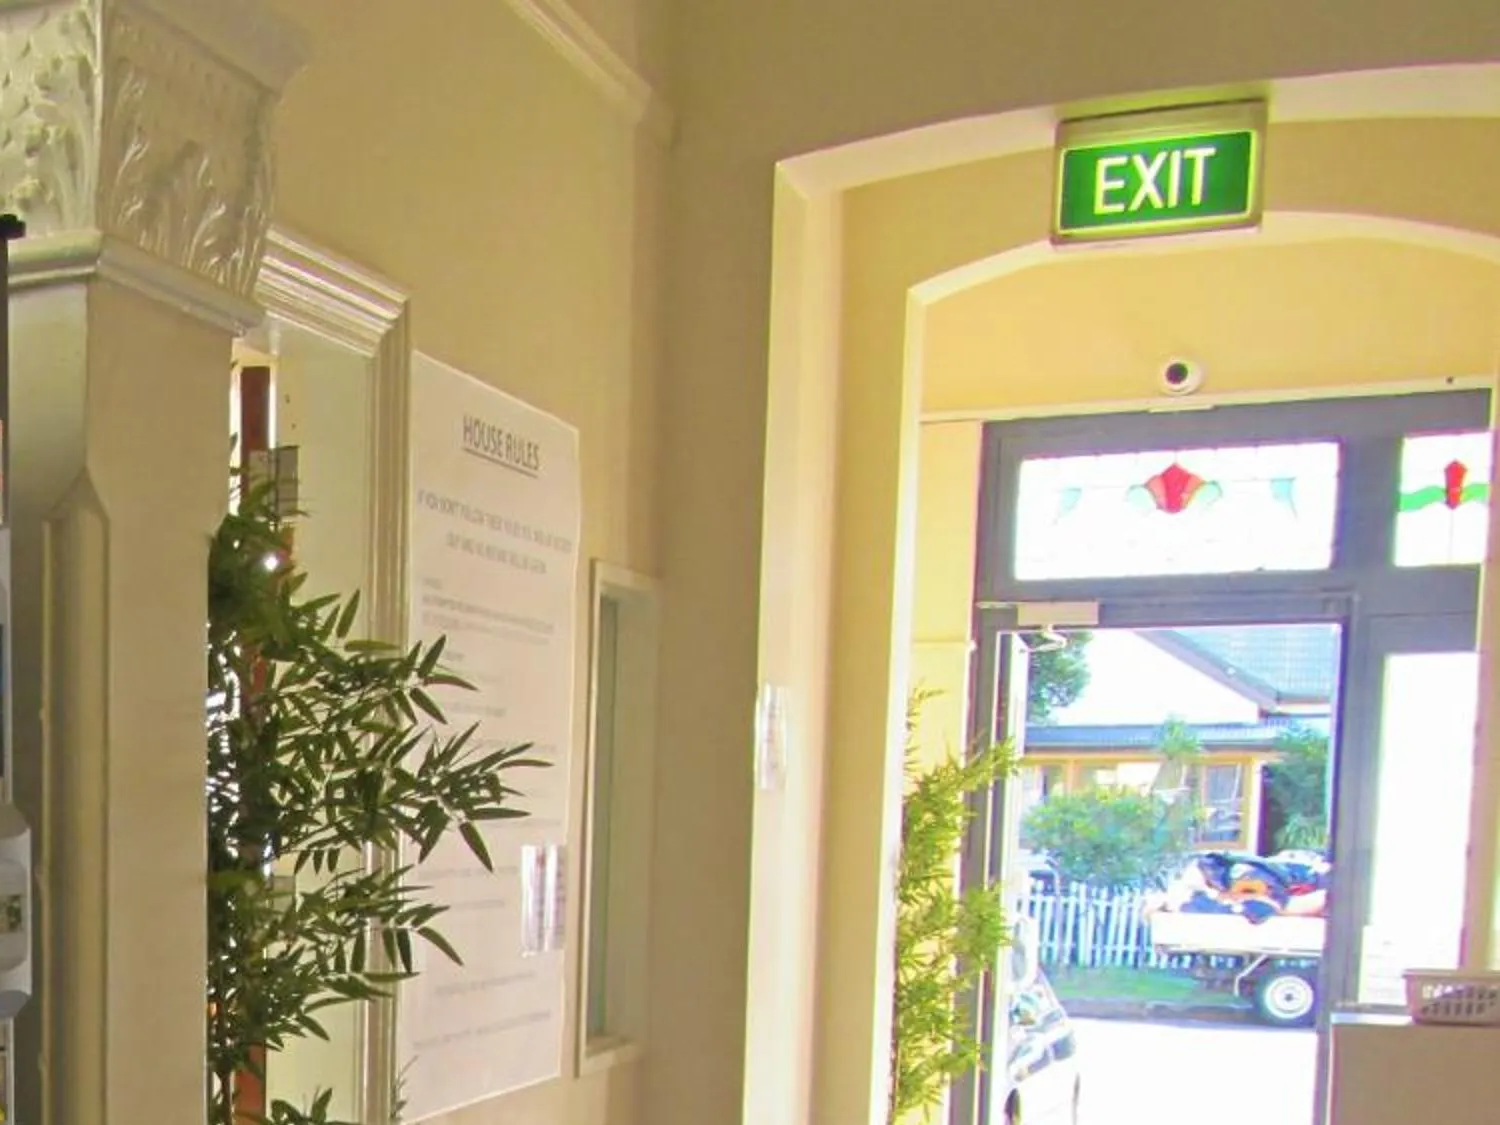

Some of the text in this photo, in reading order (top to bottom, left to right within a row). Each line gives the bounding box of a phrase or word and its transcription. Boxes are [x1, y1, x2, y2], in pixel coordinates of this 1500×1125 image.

[1093, 147, 1216, 215] EXIT
[462, 415, 540, 471] HOUSE RULES
